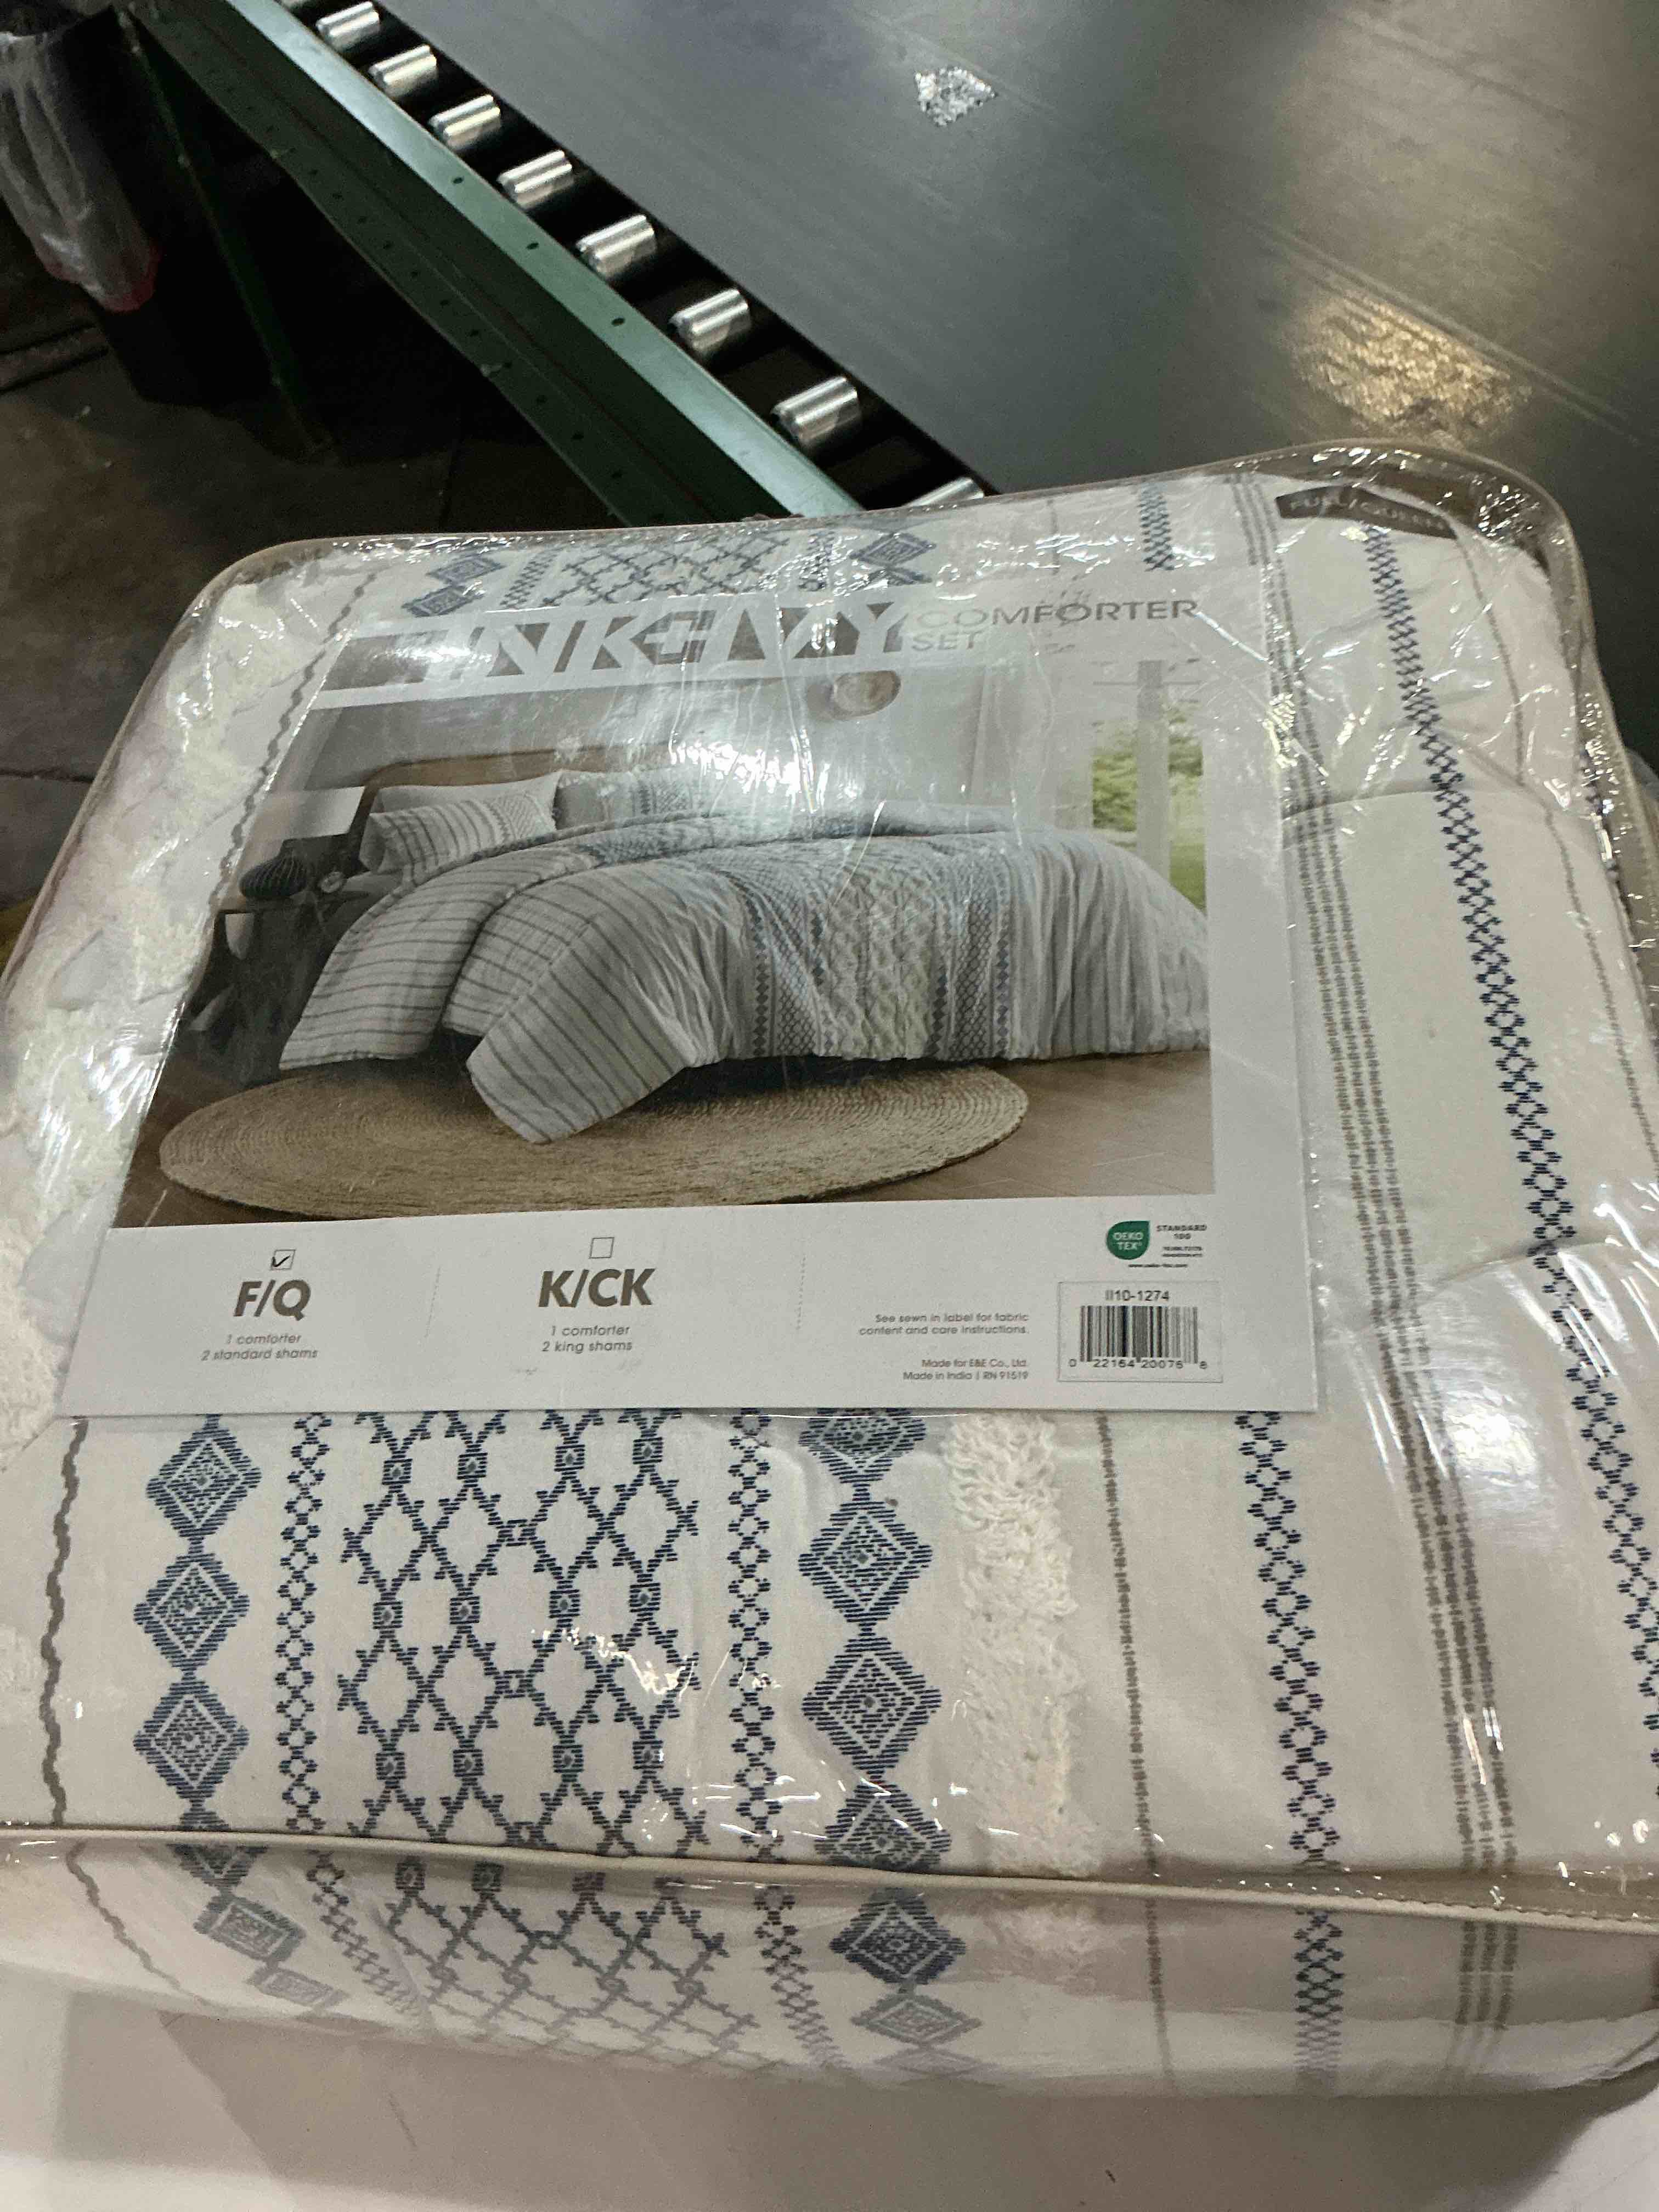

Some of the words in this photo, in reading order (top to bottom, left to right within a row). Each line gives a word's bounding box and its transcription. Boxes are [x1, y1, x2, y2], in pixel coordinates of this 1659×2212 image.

[915, 599, 1198, 629] COMFORTER
[911, 630, 977, 652] SET
[539, 1268, 656, 1308] K/CK
[234, 1279, 312, 1321] F/Q
[875, 1314, 895, 1322] See
[945, 1313, 973, 1322] label
[976, 1313, 991, 1322] for
[995, 1313, 1029, 1322] fabric
[551, 1325, 556, 1335] 1
[561, 1325, 630, 1336] comforter
[860, 1325, 902, 1335] content
[906, 1325, 928, 1334] and
[962, 1324, 1030, 1334] instructions.
[236, 1334, 301, 1345] comforter
[541, 1341, 550, 1352] 2
[554, 1340, 584, 1354] king
[588, 1340, 633, 1352] shams
[201, 1350, 210, 1362] 2
[213, 1347, 273, 1361] standard
[275, 1347, 318, 1359] shams
[922, 1359, 951, 1368] Made
[953, 1358, 967, 1368] for
[903, 1372, 933, 1380] Made
[935, 1372, 944, 1380] in
[947, 1371, 972, 1380] India
